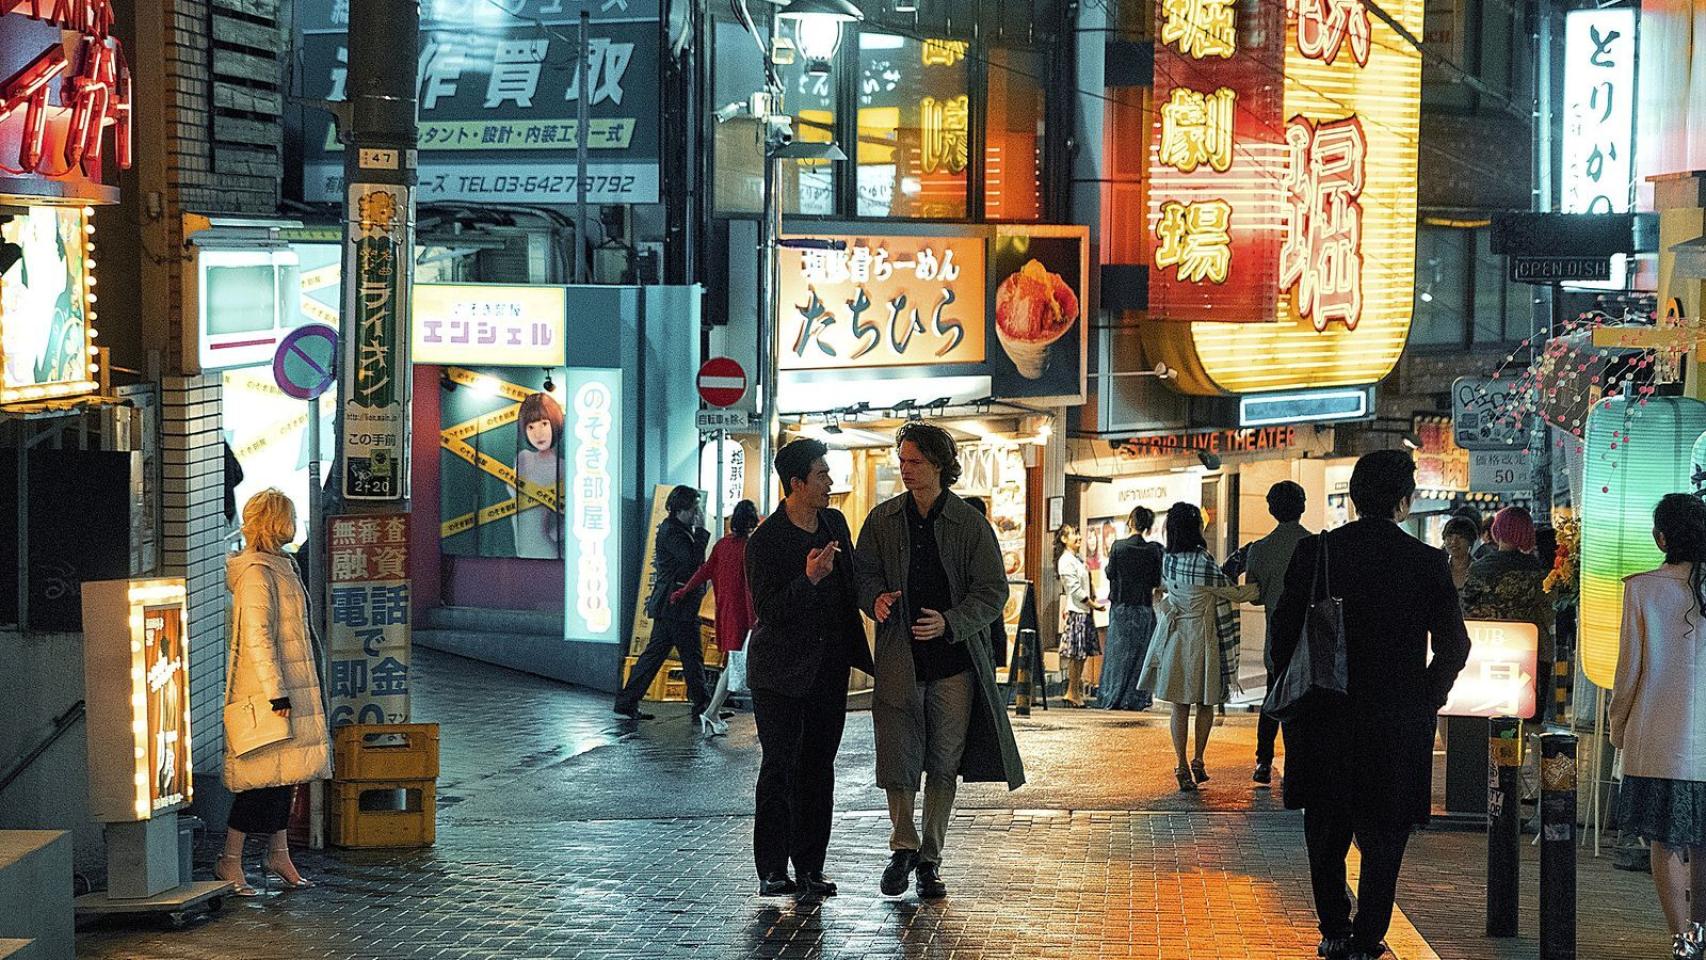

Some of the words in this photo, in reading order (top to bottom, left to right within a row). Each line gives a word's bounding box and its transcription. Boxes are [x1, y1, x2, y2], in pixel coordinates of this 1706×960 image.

[417, 123, 625, 145] タント・設計・内装工一式
[371, 153, 391, 163] 47
[1519, 259, 1562, 277] OPEN
[1567, 258, 1606, 276] DISH
[423, 321, 552, 346] エンジェル
[791, 284, 965, 359] たちひら
[358, 281, 393, 396] ライオン
[348, 433, 397, 447] この手前
[1128, 434, 1178, 459] STRIP
[1183, 432, 1220, 456] LIVE
[1226, 427, 1297, 451] THEATER
[1495, 468, 1514, 484] 50
[332, 518, 407, 546] 無審査
[331, 547, 408, 581] 融資
[331, 584, 409, 628] 電話
[354, 627, 386, 658] で
[331, 656, 408, 699] 即金
